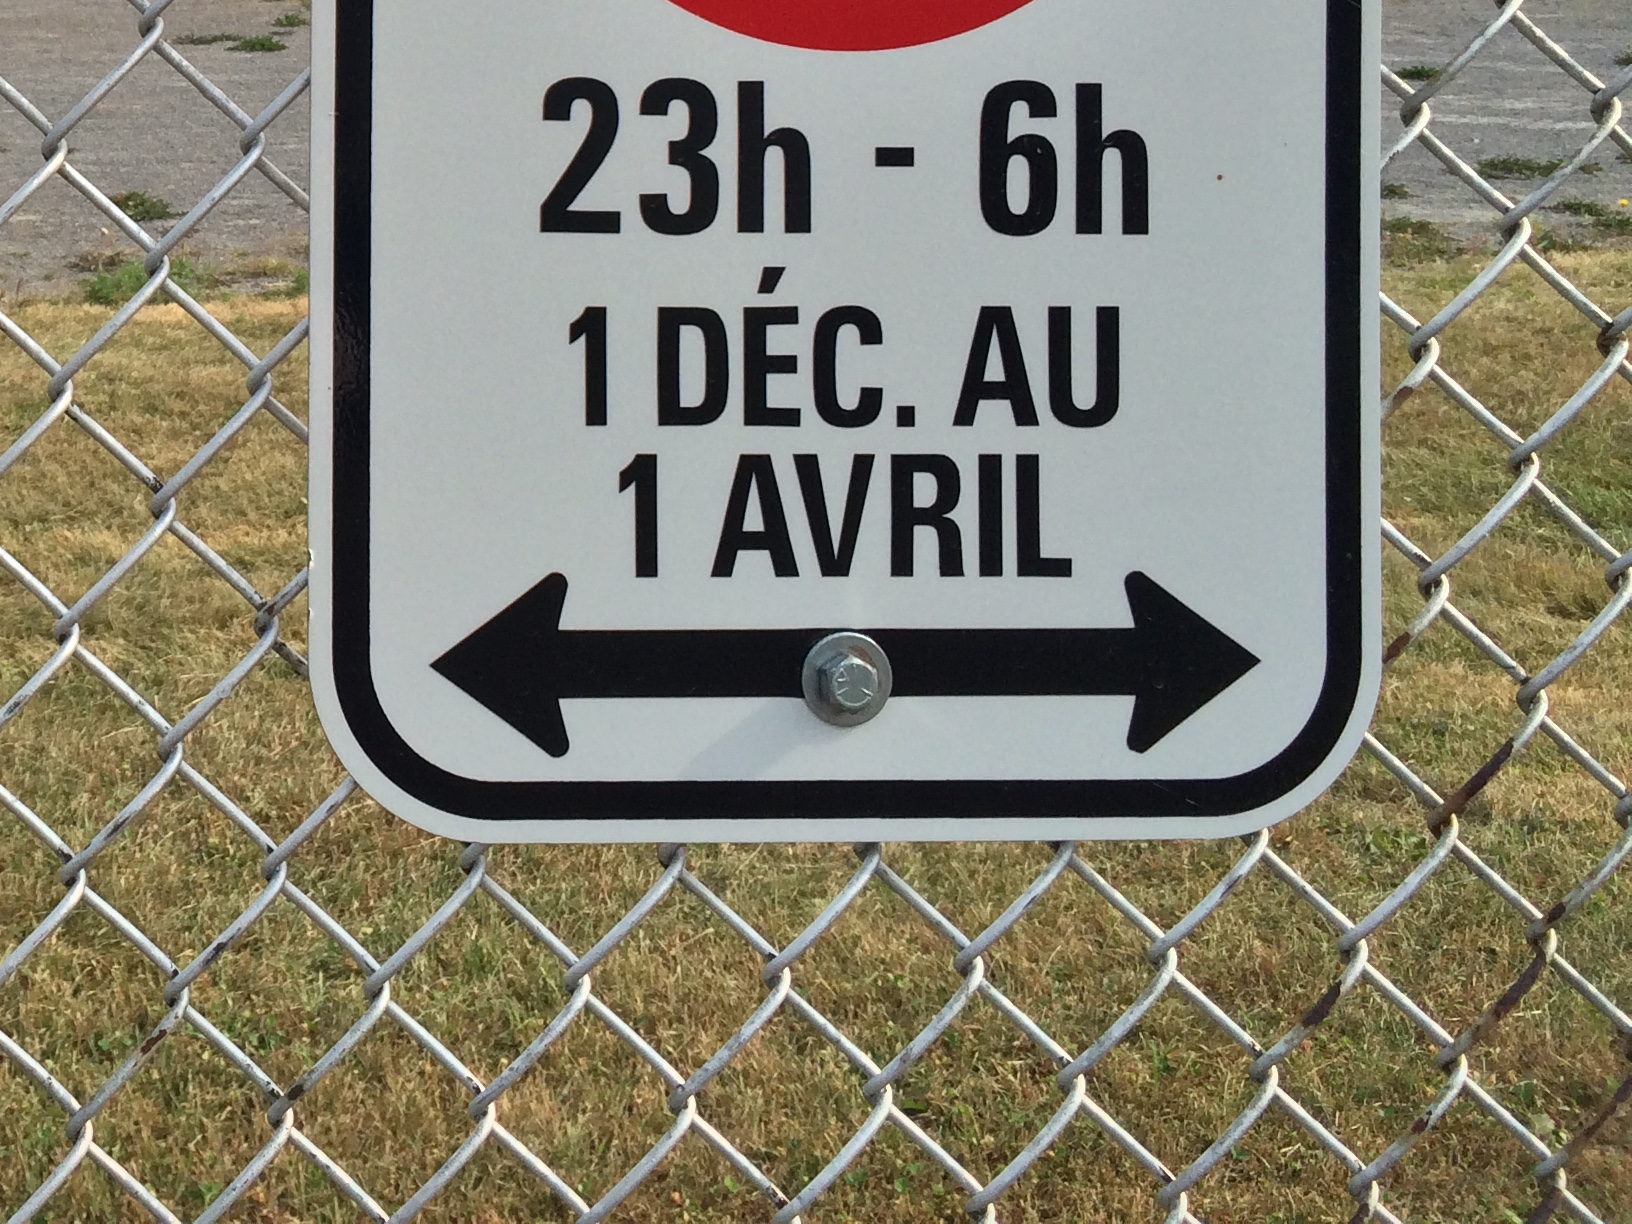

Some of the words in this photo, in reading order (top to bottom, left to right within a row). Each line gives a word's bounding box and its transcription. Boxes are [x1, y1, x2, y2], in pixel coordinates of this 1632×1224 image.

[540, 76, 812, 236] 23h
[875, 146, 915, 168] -
[979, 79, 1149, 237] 6h
[568, 305, 608, 427] 1
[657, 266, 916, 429] DÉC.
[952, 305, 1120, 429] AU
[618, 453, 658, 578] 1
[710, 453, 1073, 578] AVRIL
